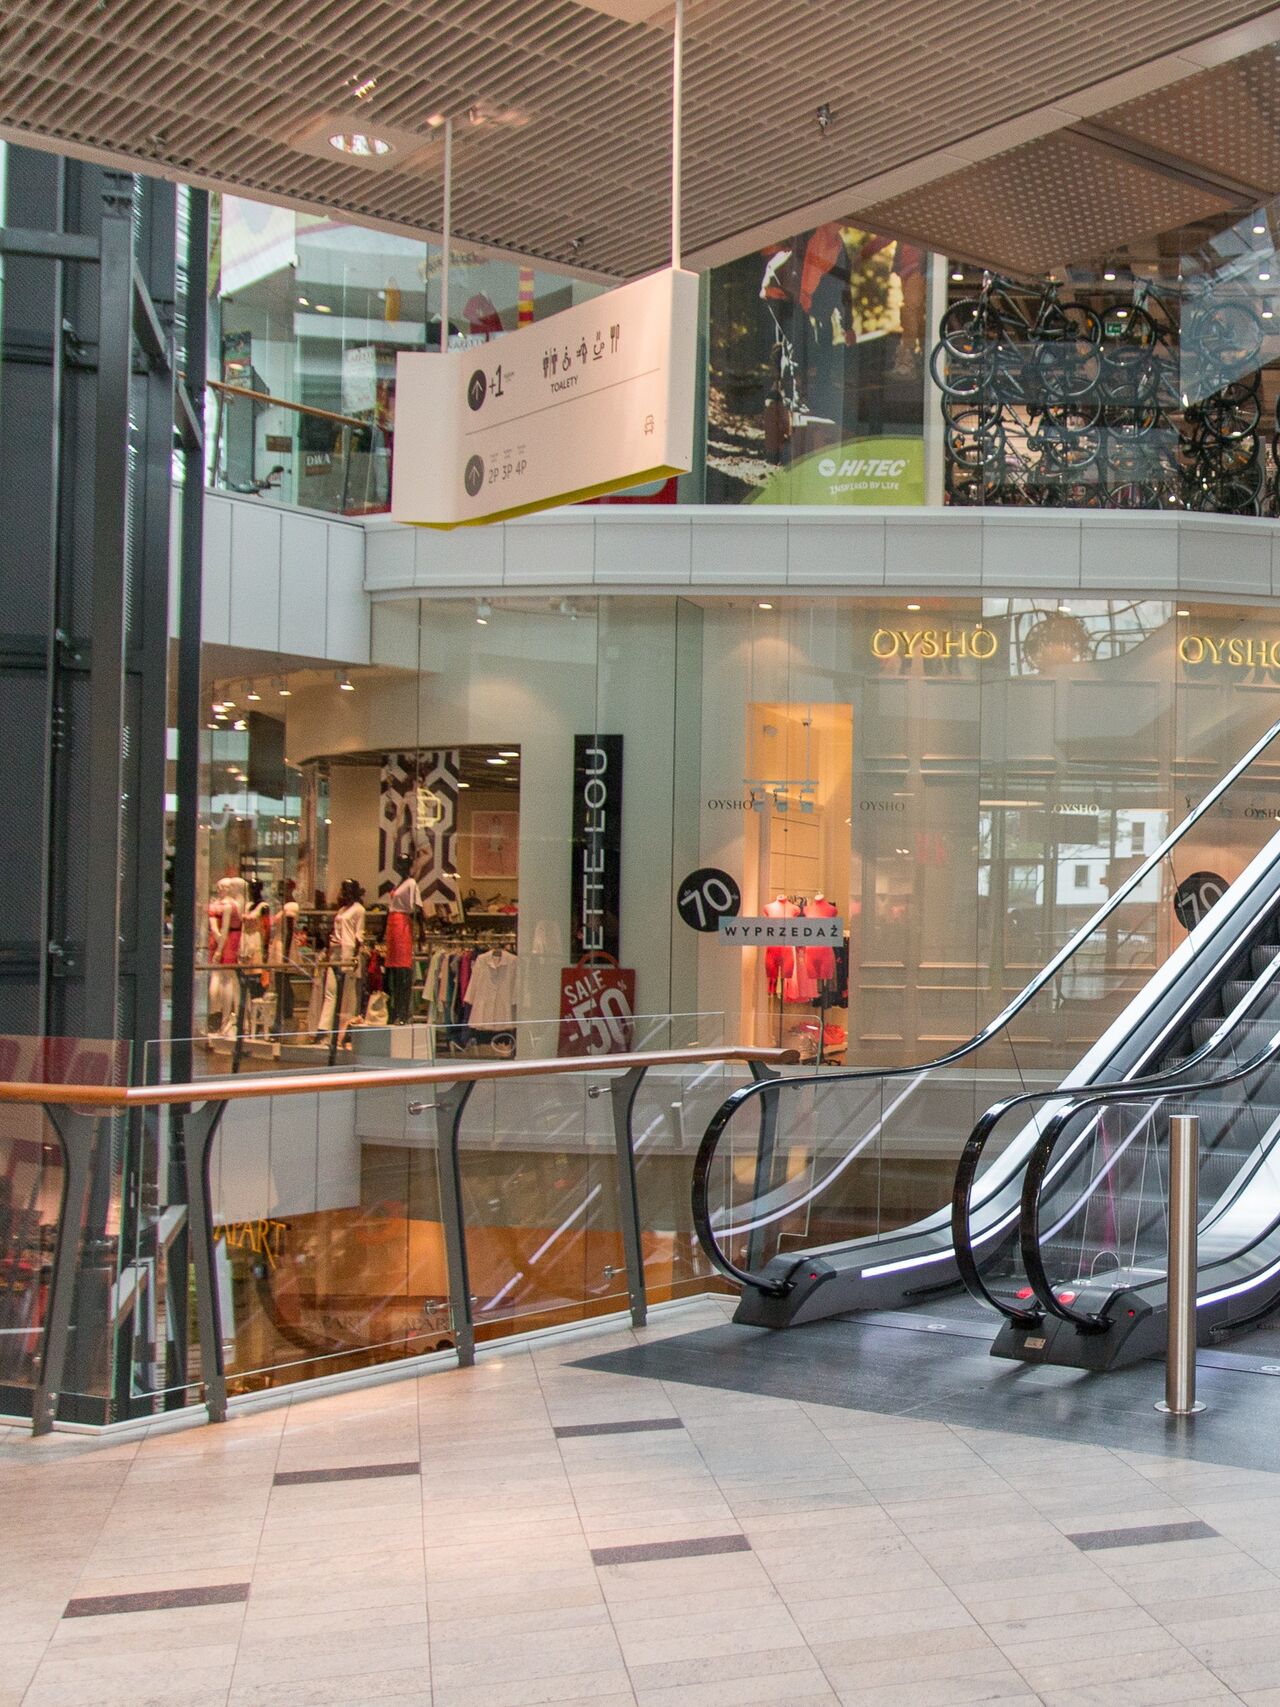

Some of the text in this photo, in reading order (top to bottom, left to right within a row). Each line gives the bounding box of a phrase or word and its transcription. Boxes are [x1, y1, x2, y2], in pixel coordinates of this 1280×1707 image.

[550, 376, 579, 393] TOALETY
[837, 459, 906, 476] HI-TEC
[871, 629, 998, 658] OYSHO
[708, 799, 753, 810] OYSHO
[859, 800, 905, 812] OYSHO
[1053, 803, 1100, 815] OYSHO
[582, 748, 608, 950] ETTE LOU
[725, 924, 839, 938] WYPRZEDAŻ
[564, 970, 607, 1005] SALE
